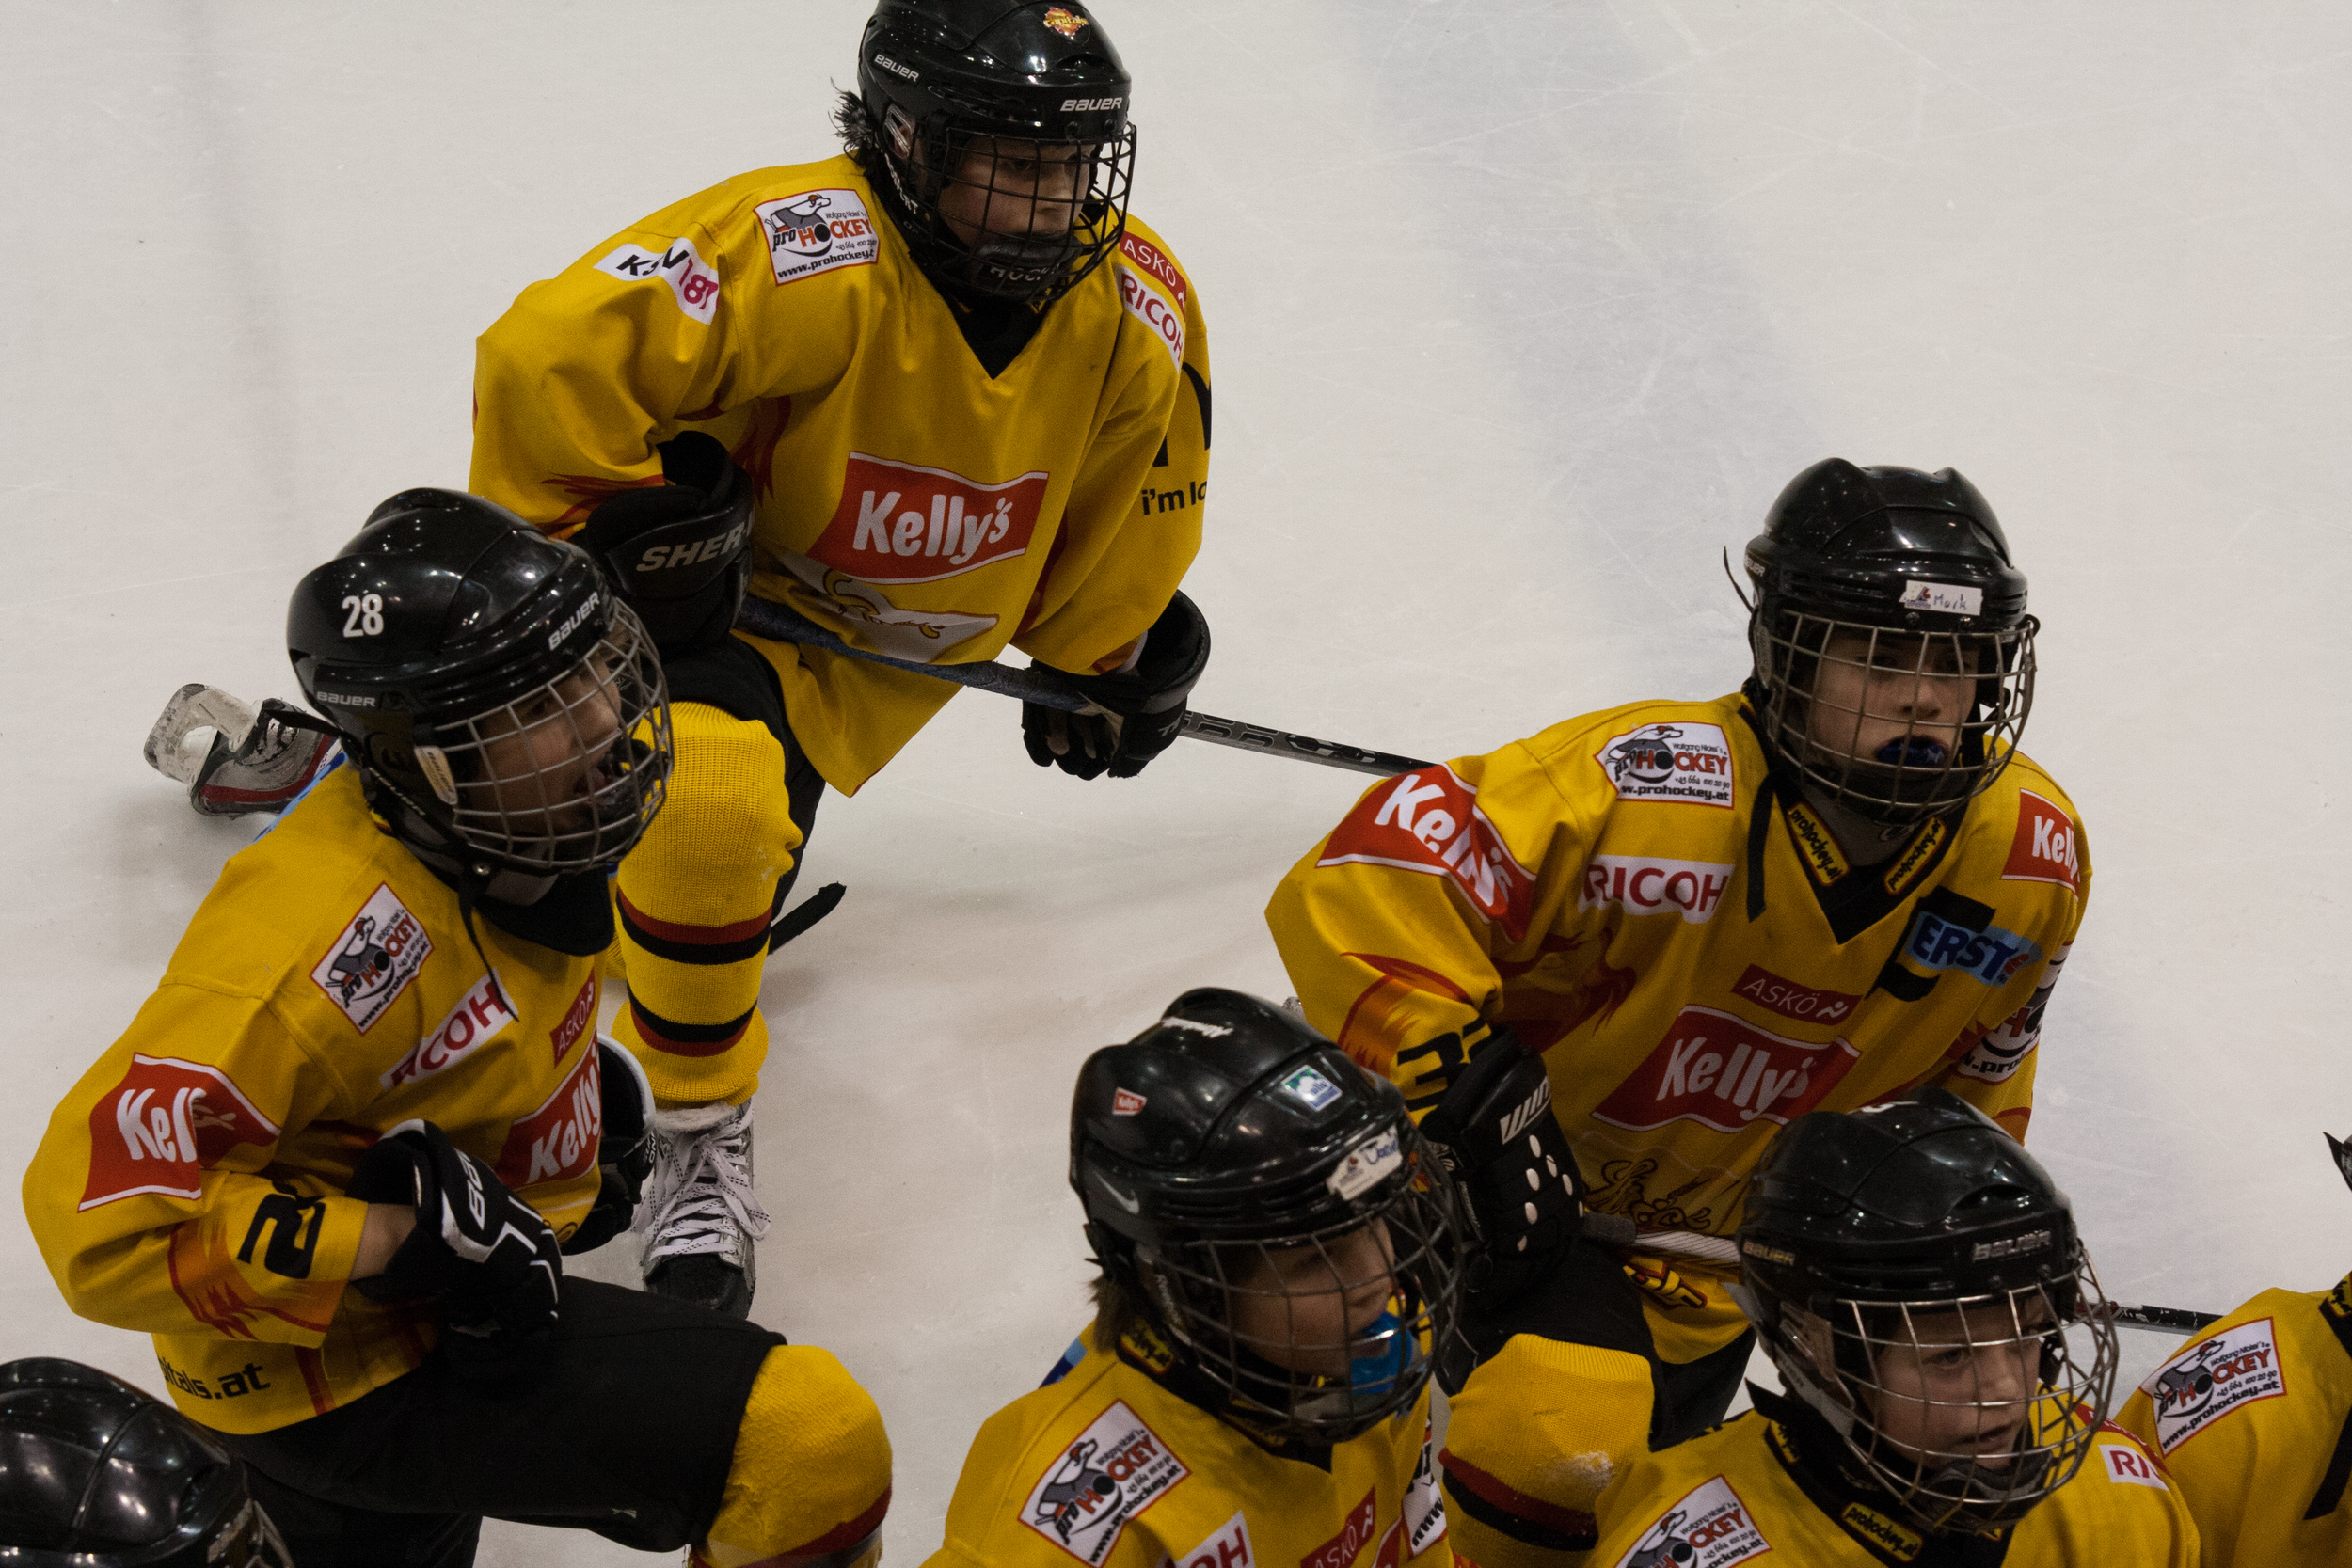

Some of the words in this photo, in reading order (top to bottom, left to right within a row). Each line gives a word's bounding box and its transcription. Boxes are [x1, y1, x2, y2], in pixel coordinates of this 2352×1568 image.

[678, 258, 719, 311] 187
[1124, 239, 1176, 286] ASKÖ
[1121, 273, 1184, 362] RICOH
[853, 490, 1012, 564] Kelly's
[342, 594, 384, 638] 28
[1582, 864, 1729, 912] RICOH
[1743, 978, 1819, 1015] ASKÖ
[557, 994, 587, 1057] ASKÖ
[1656, 1037, 1817, 1120] Kelly's
